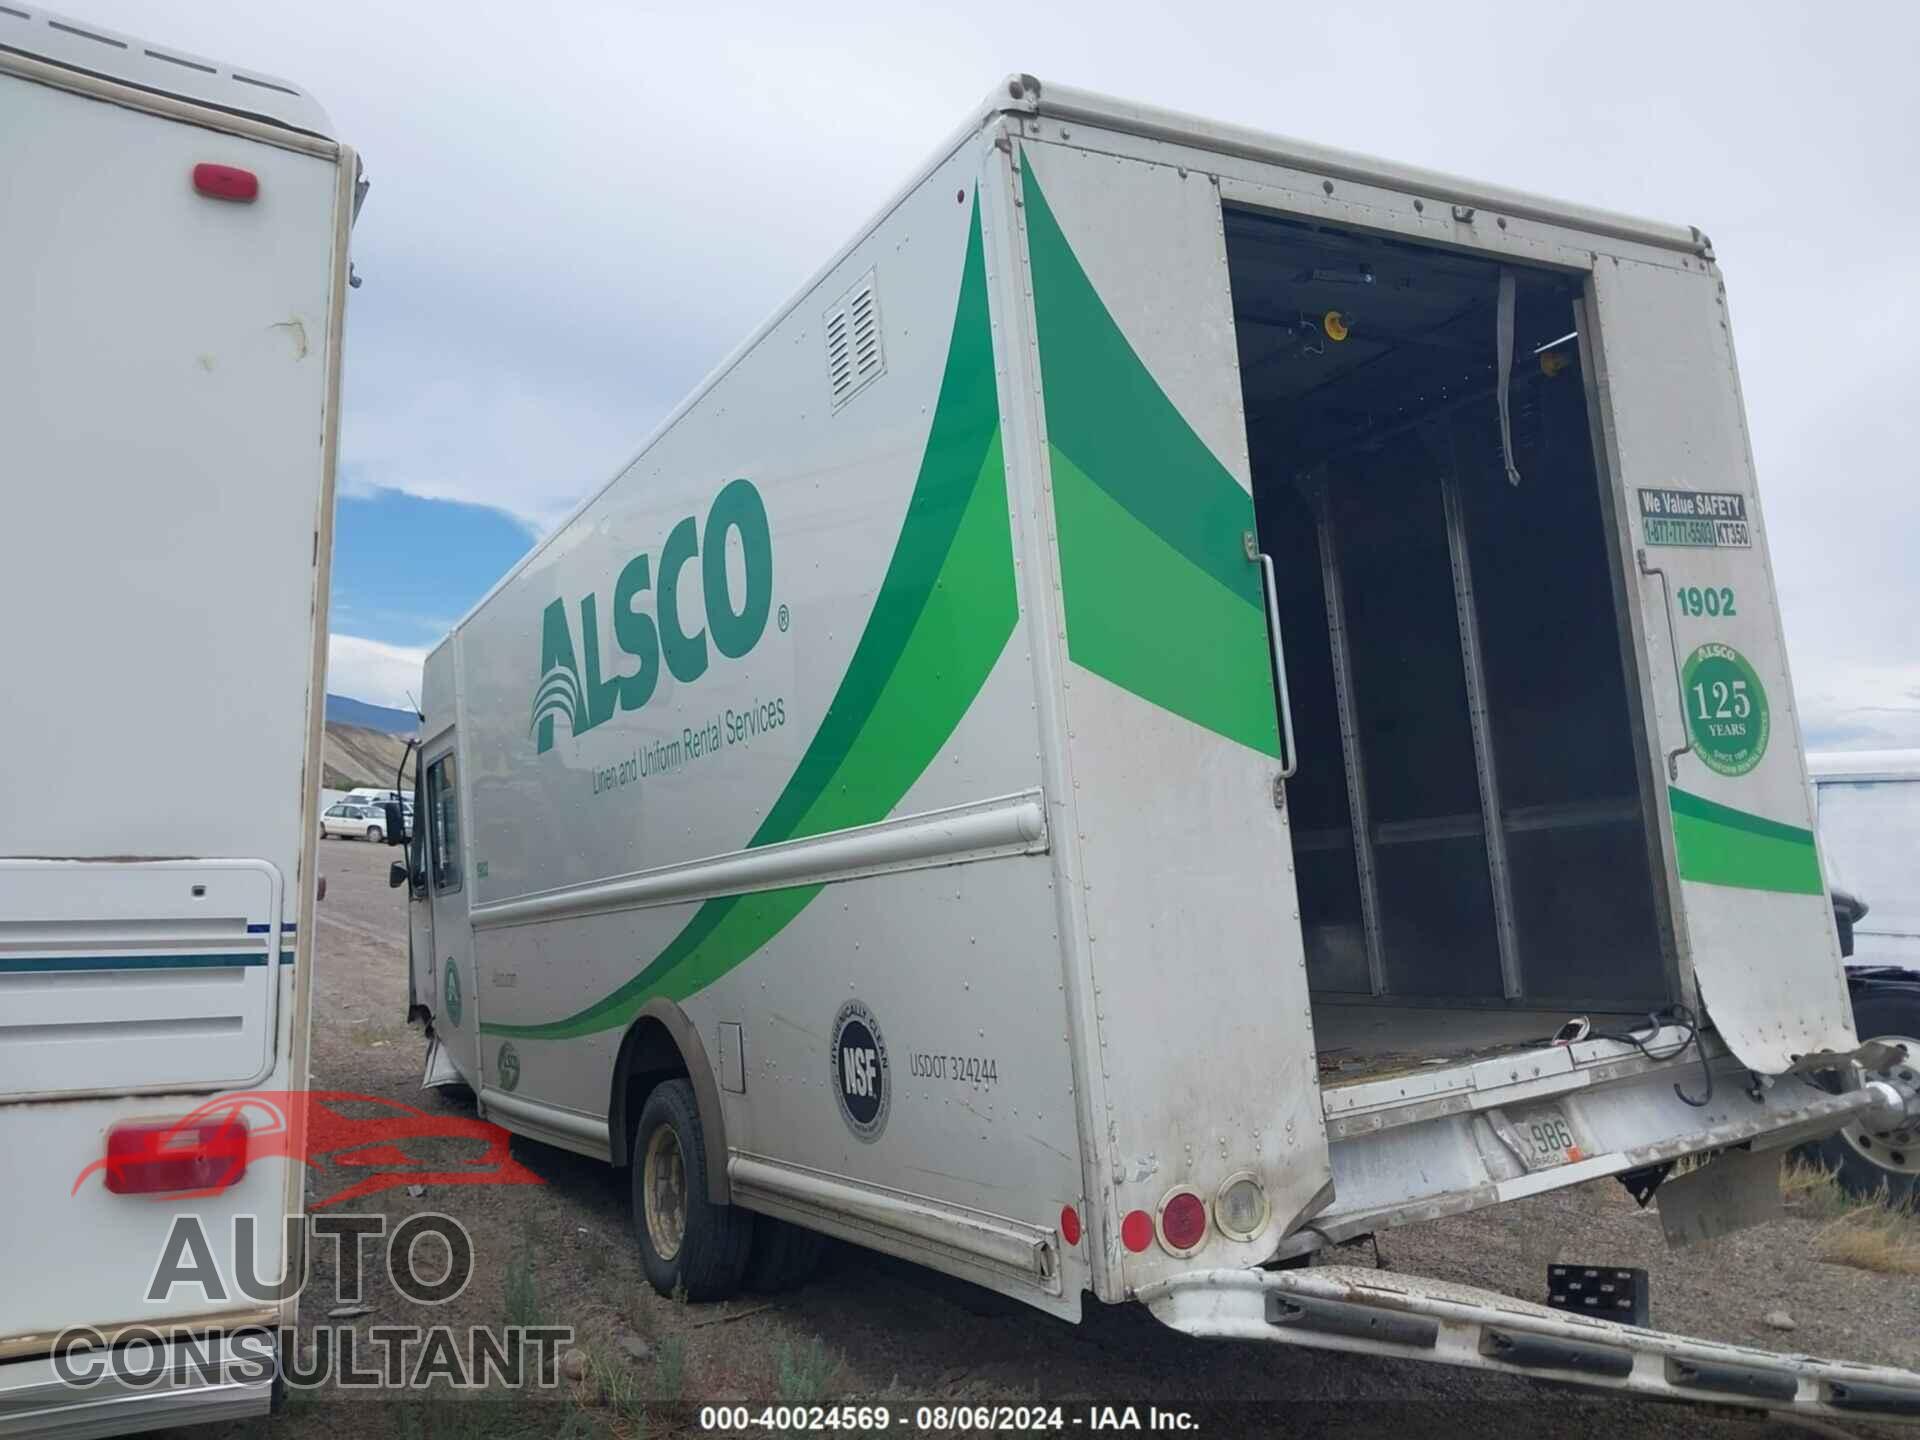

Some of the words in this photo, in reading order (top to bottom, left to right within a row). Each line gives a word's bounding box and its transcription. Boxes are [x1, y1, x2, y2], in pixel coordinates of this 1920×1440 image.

[1642, 491, 1660, 512] We
[1663, 493, 1694, 514] Value
[1696, 494, 1740, 516] SAFETY
[1716, 521, 1748, 544] KT350
[1677, 587, 1736, 616] 1902
[529, 479, 773, 755] ALSCO
[1698, 644, 1736, 662] ALSCO
[1692, 681, 1751, 720] 125
[1708, 723, 1747, 736] YEARS
[593, 767, 617, 794] Linen
[619, 753, 637, 784] and
[640, 740, 682, 777] Uniform
[683, 716, 721, 760] Rental
[726, 698, 785, 744] Services
[843, 1047, 876, 1096] NSF
[911, 1053, 946, 1079] USDOT
[952, 1056, 998, 1084] 324244
